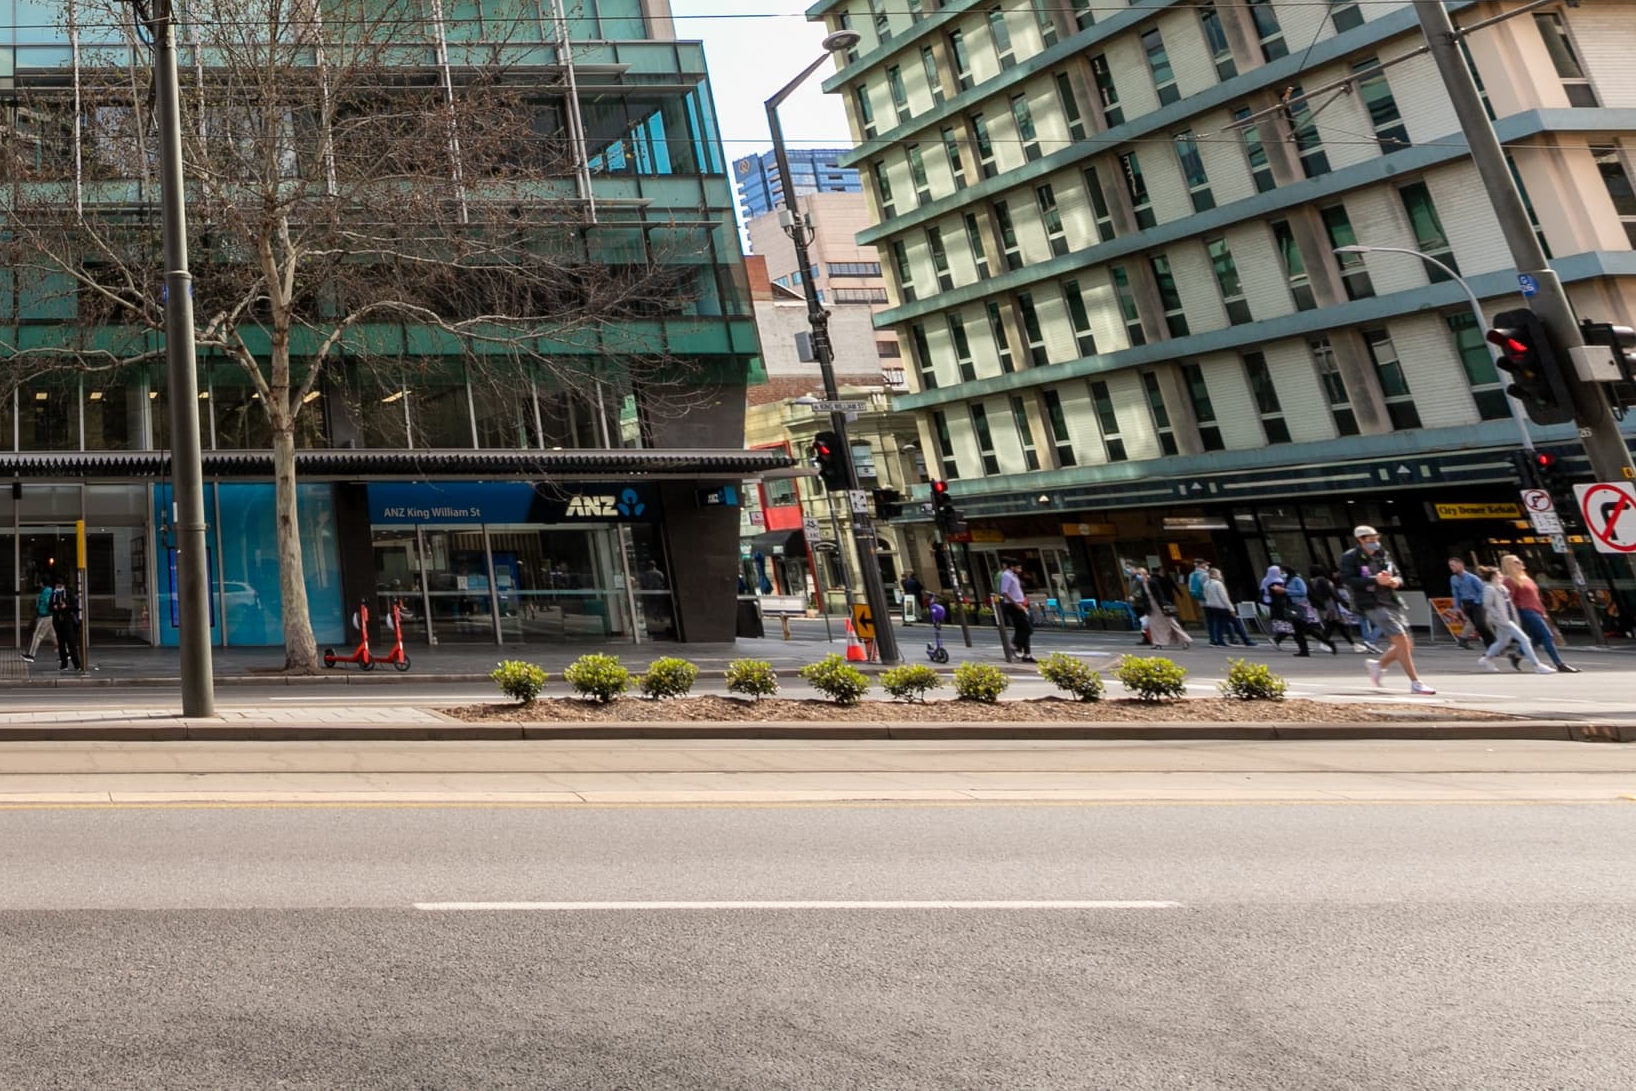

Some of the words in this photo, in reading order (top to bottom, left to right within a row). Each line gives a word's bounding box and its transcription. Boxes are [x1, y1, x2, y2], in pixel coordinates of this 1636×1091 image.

[384, 508, 405, 517] ANZ
[407, 508, 430, 519] King
[431, 507, 469, 517] William
[470, 507, 481, 517] St
[565, 496, 619, 516] ANZ
